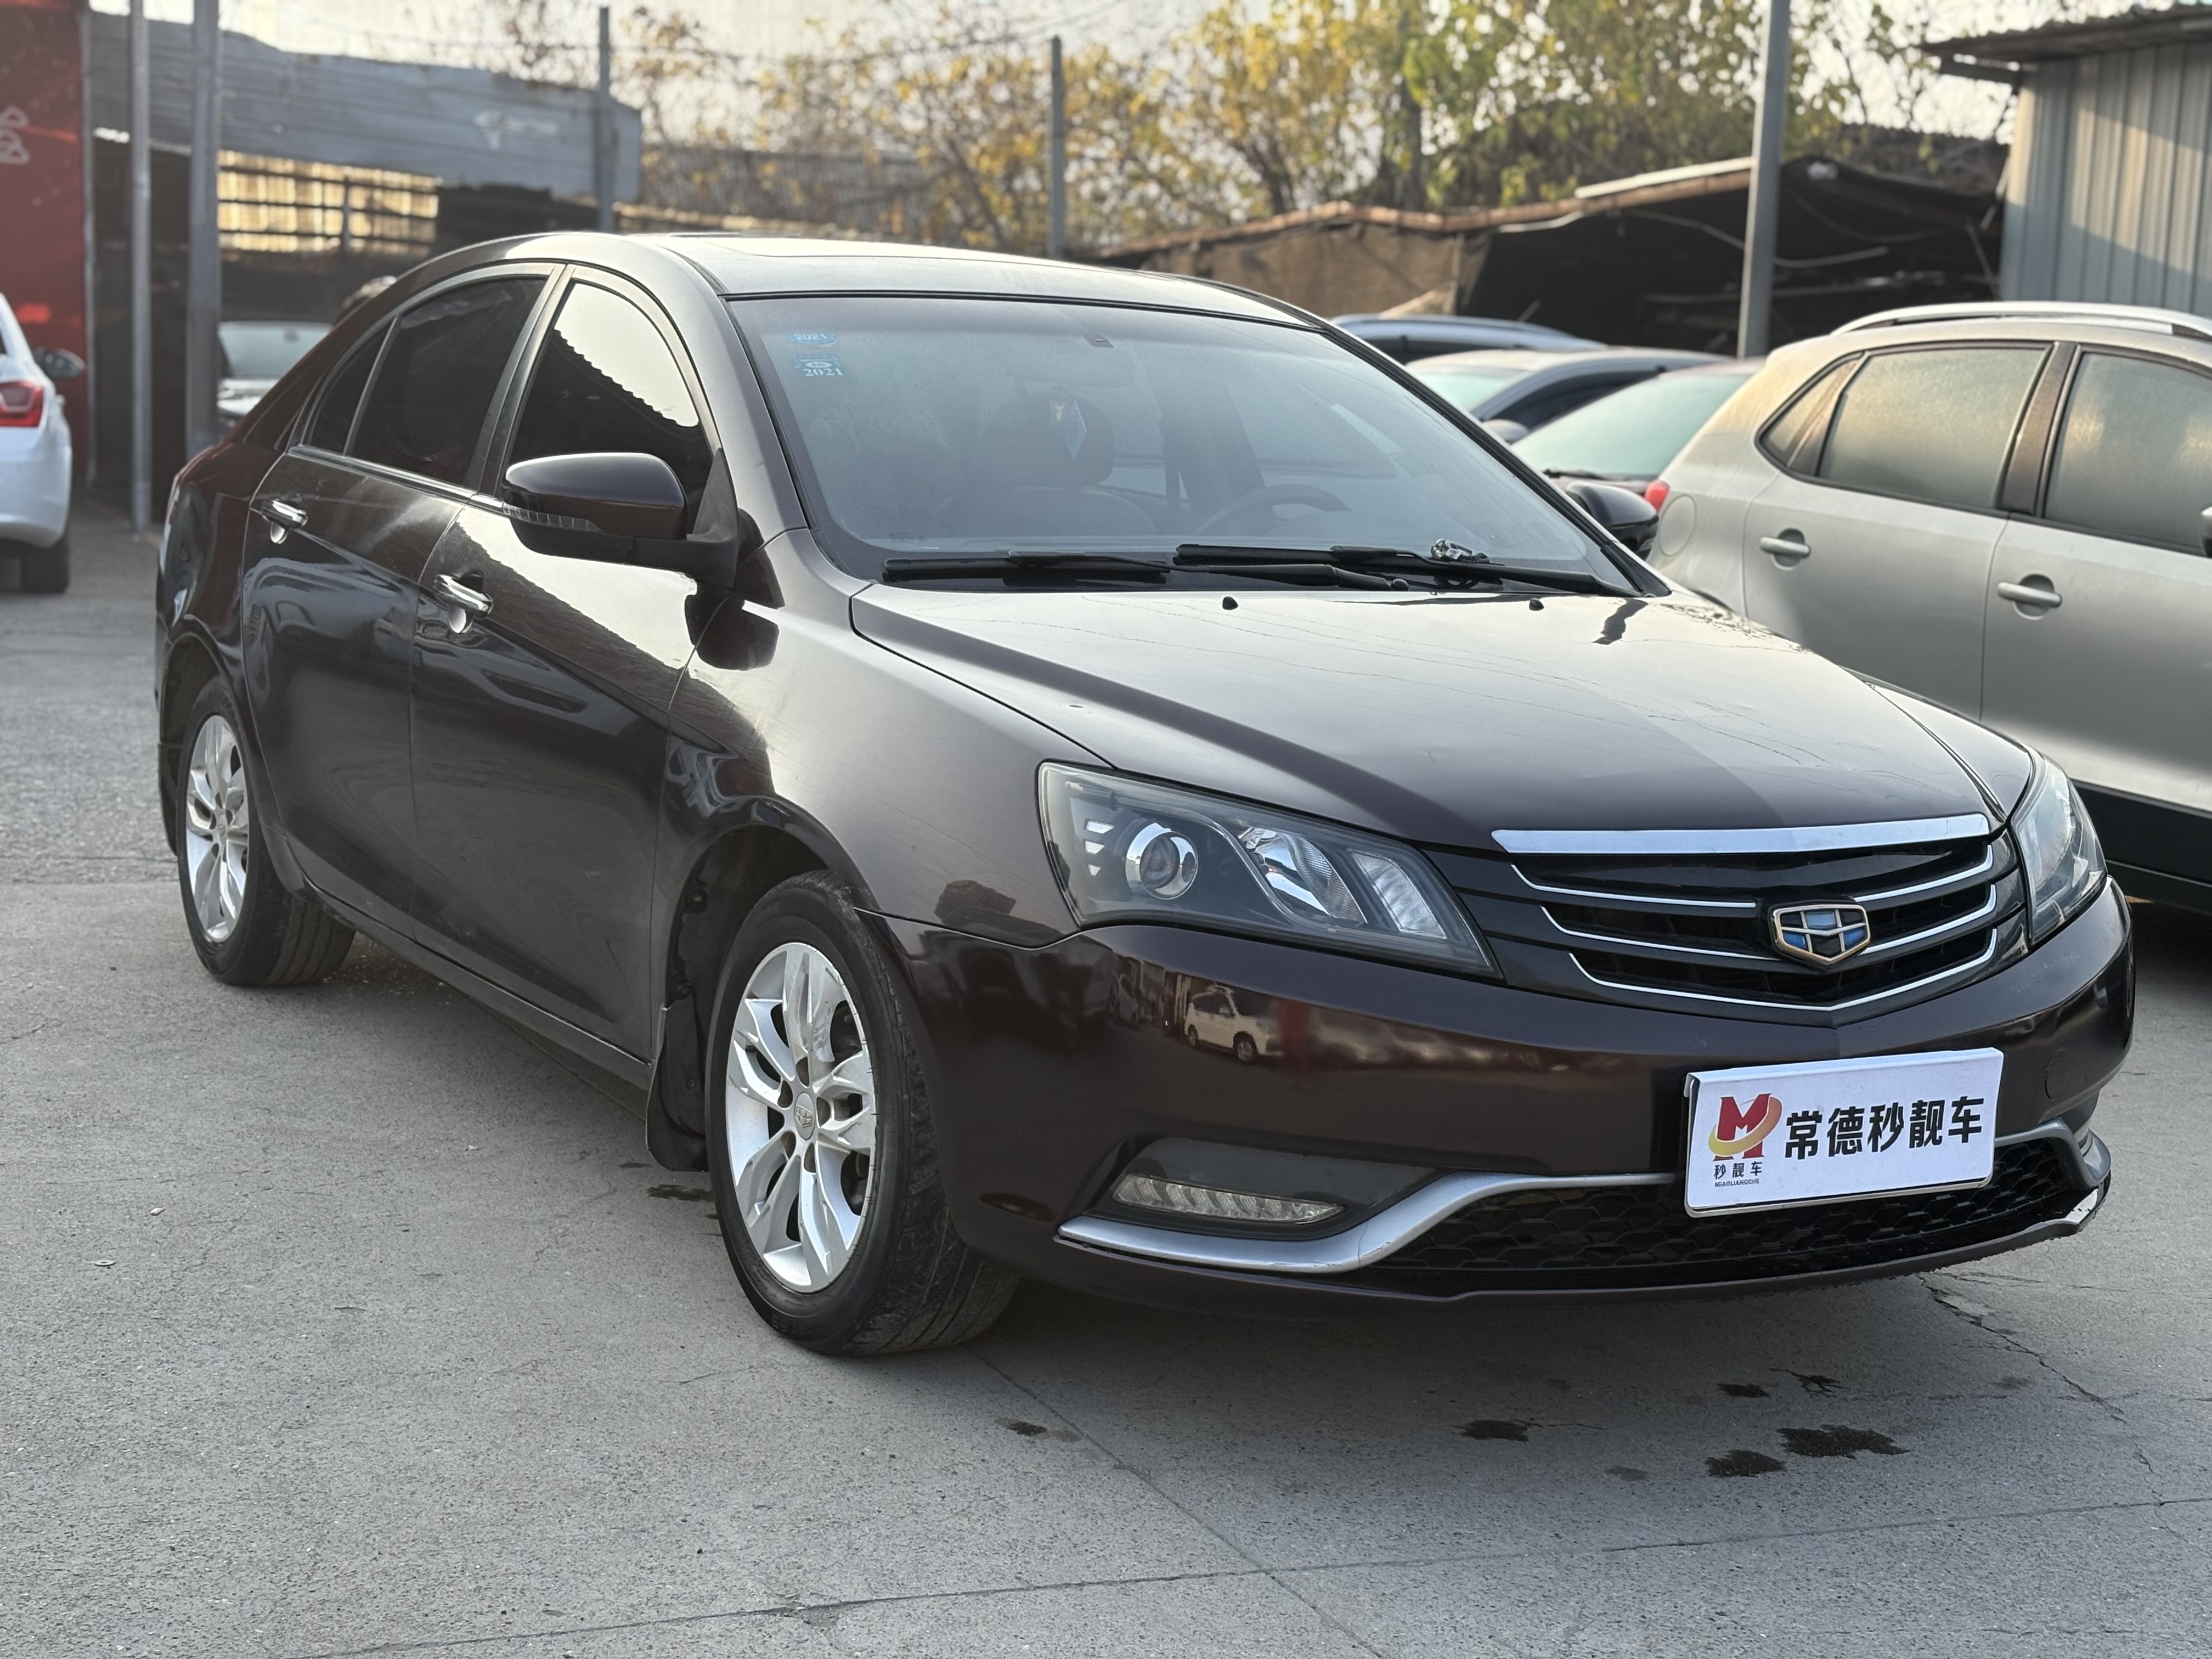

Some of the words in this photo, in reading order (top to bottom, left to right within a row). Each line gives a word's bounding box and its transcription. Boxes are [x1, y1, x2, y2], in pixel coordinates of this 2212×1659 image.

[803, 368, 843, 376] 2021
[1785, 1096, 1984, 1160] 常德秒靓车
[1713, 1161, 1763, 1180] 秒靓车
